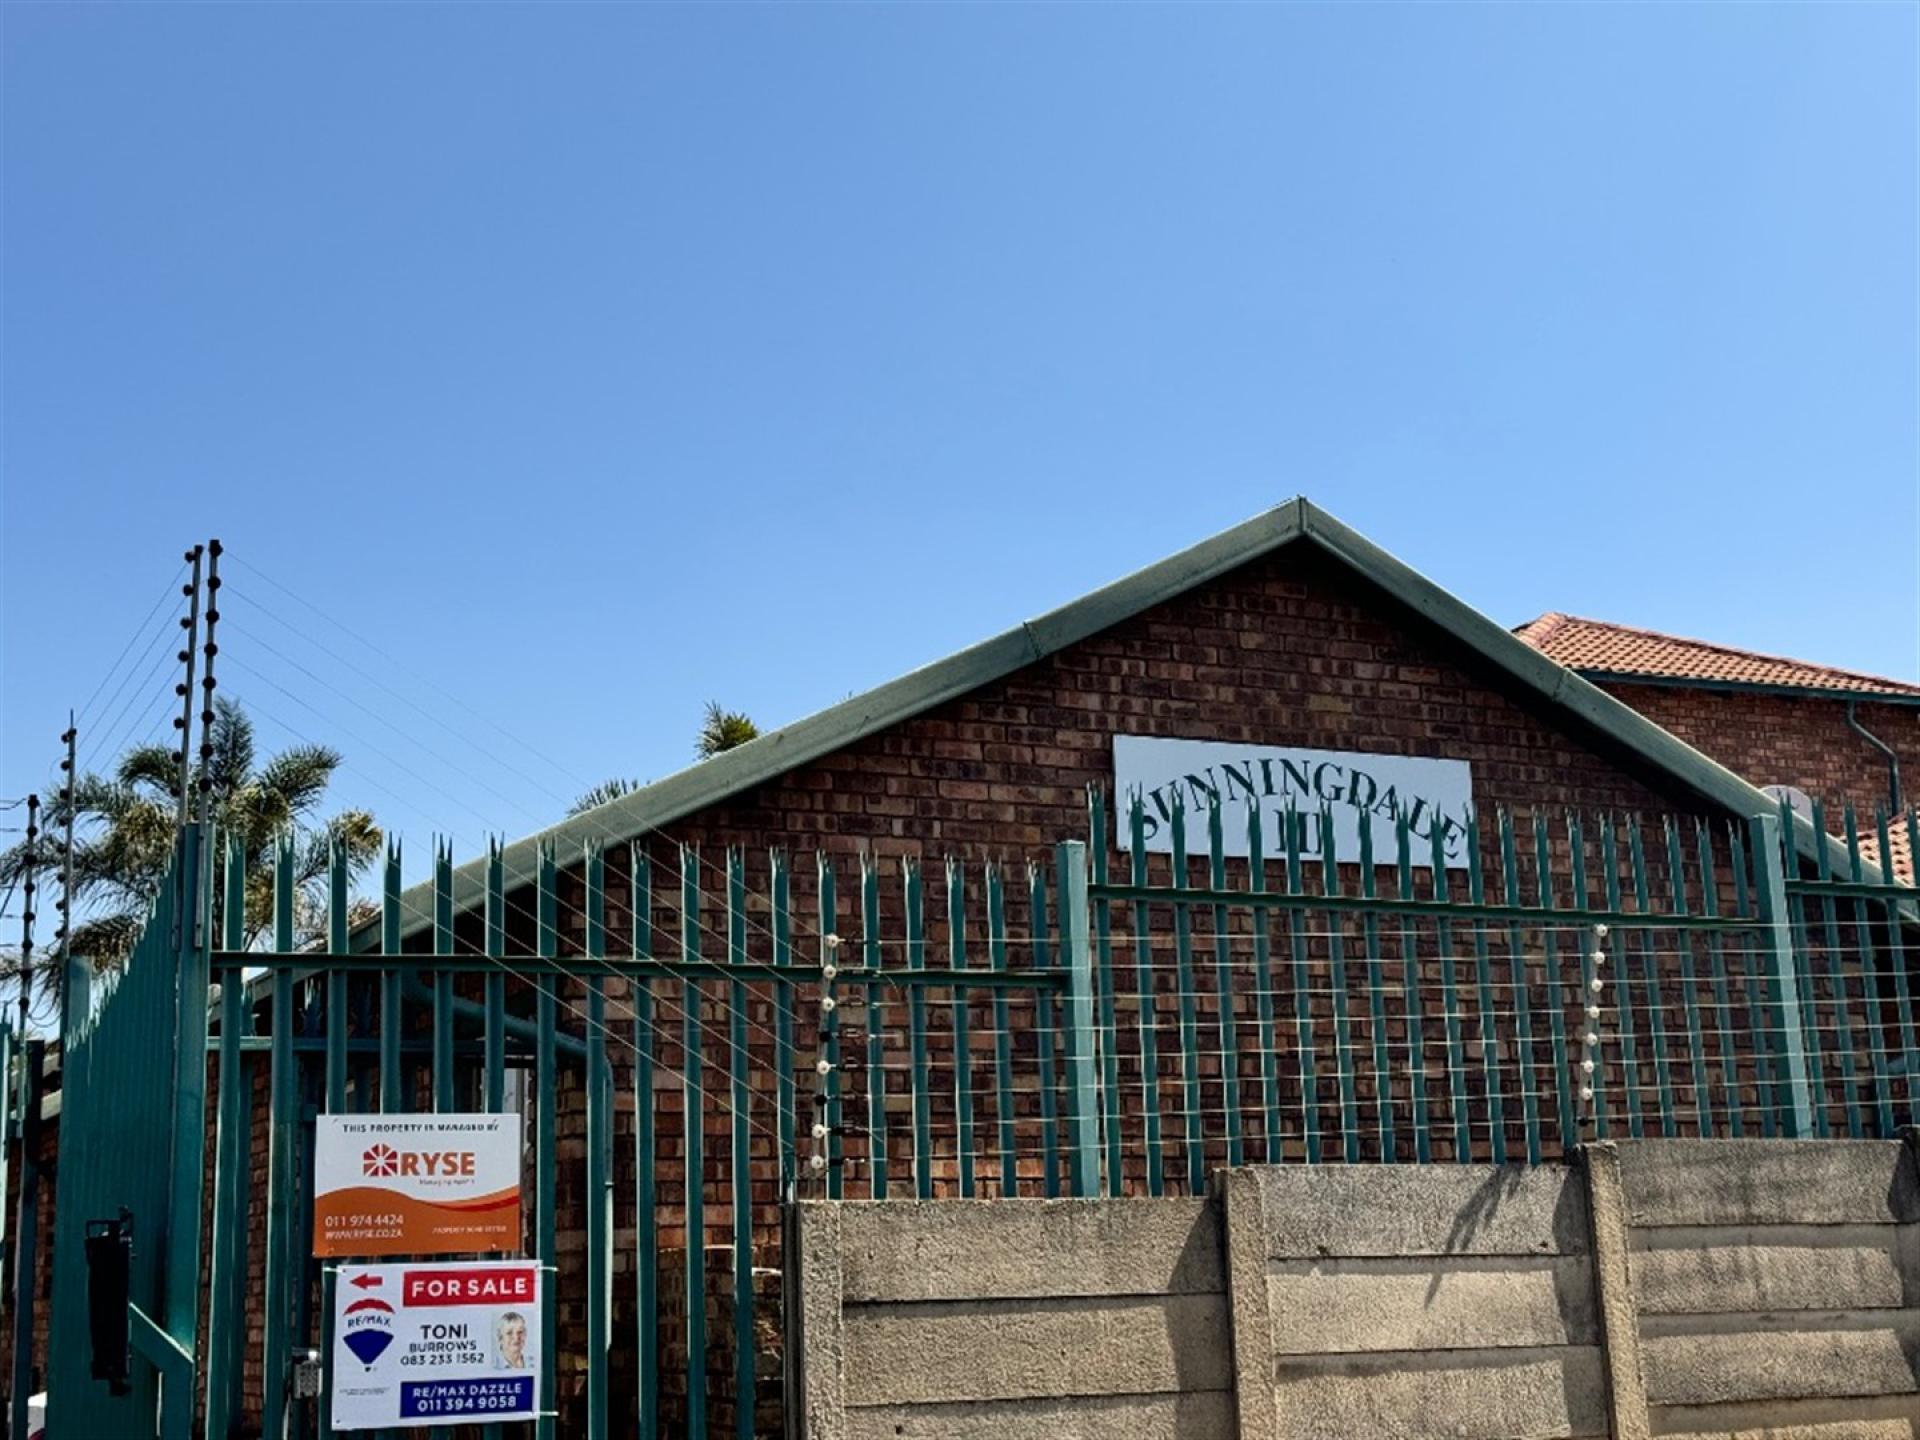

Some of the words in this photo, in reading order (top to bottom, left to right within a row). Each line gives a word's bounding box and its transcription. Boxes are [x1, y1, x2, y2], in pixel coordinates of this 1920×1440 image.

[1126, 758, 1467, 859] SUNNINGDALE
[343, 1124, 367, 1133] THIS
[370, 1123, 422, 1133] PROPERTY
[401, 1152, 476, 1177] RYSE
[325, 1215, 346, 1227] 011
[350, 1214, 372, 1227] 974
[374, 1213, 404, 1226] 4424
[412, 1280, 460, 1298] FOR
[467, 1277, 527, 1295] SALE
[347, 1315, 391, 1328] RE/MAX
[420, 1323, 468, 1339] TONI
[409, 1340, 477, 1353] BURROWS
[400, 1354, 426, 1366] 083
[429, 1353, 453, 1365] 233
[413, 1386, 466, 1399] RE/MAX
[469, 1383, 522, 1397] DAZZLE
[417, 1399, 441, 1412] 011
[445, 1398, 473, 1411] 394
[478, 1396, 517, 1409] 9058
